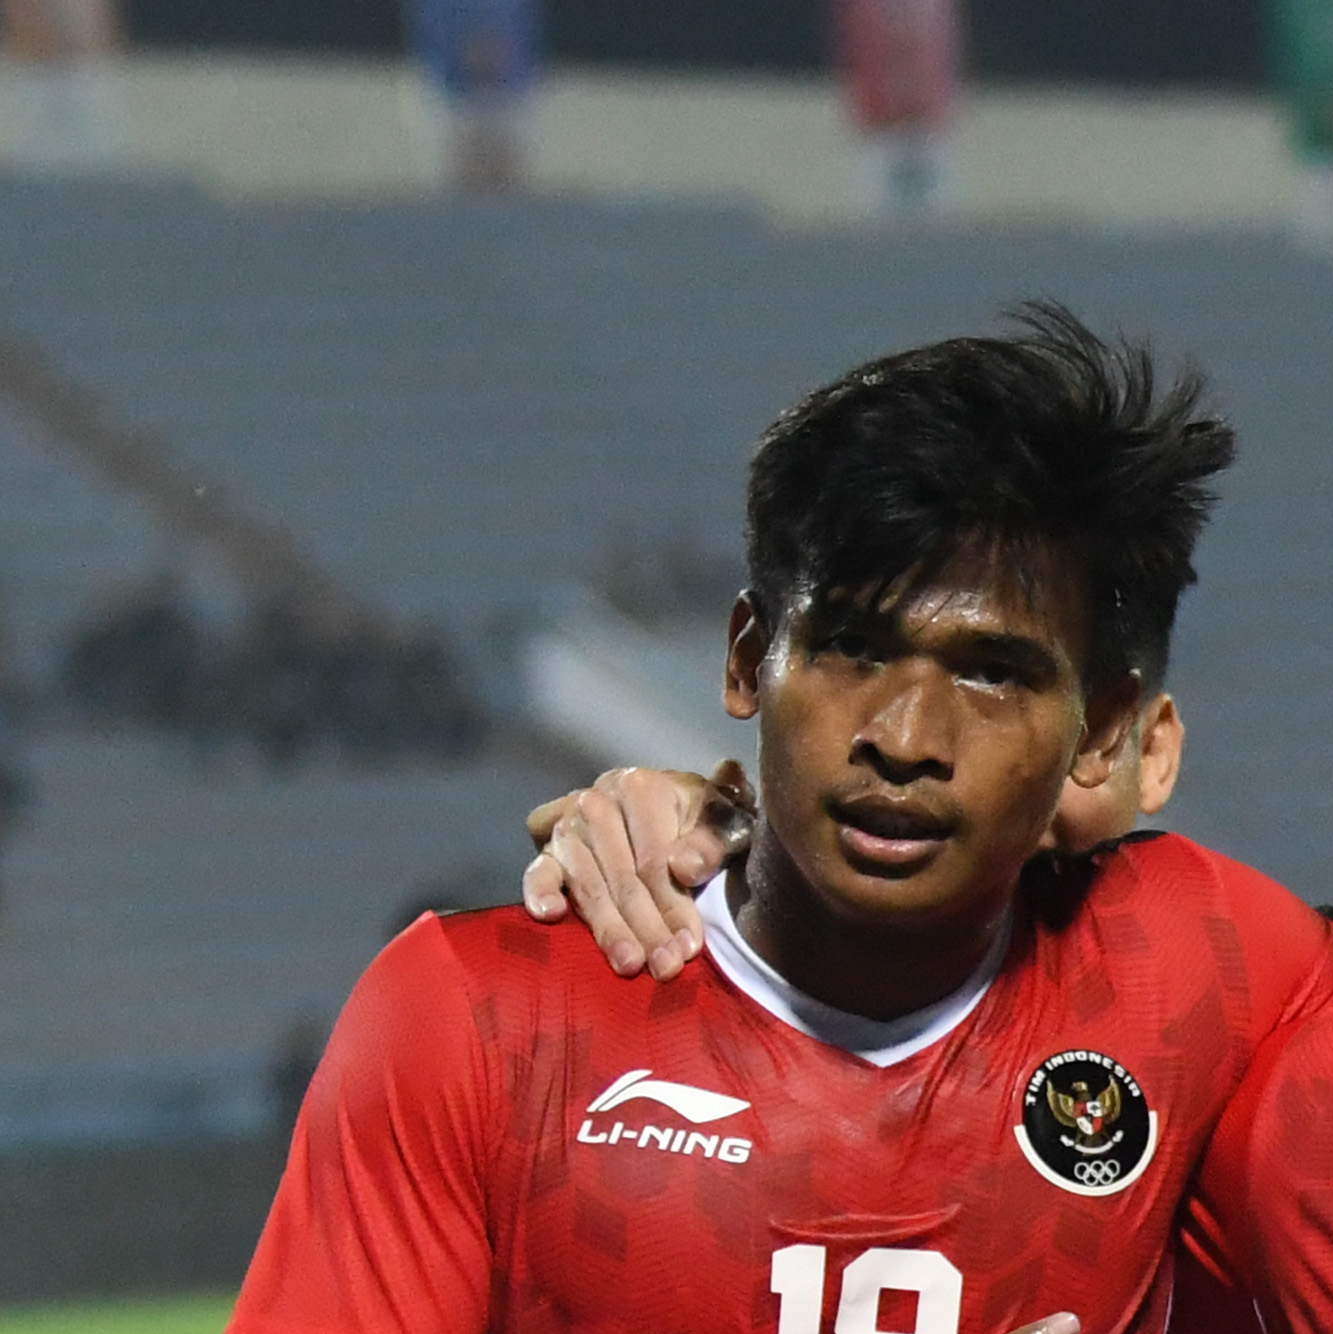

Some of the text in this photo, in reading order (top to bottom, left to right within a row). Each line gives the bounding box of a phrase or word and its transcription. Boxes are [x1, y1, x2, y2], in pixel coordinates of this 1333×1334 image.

[1025, 1050, 1141, 1106] TIM INDONESIA
[577, 1119, 752, 1164] LI-NING
